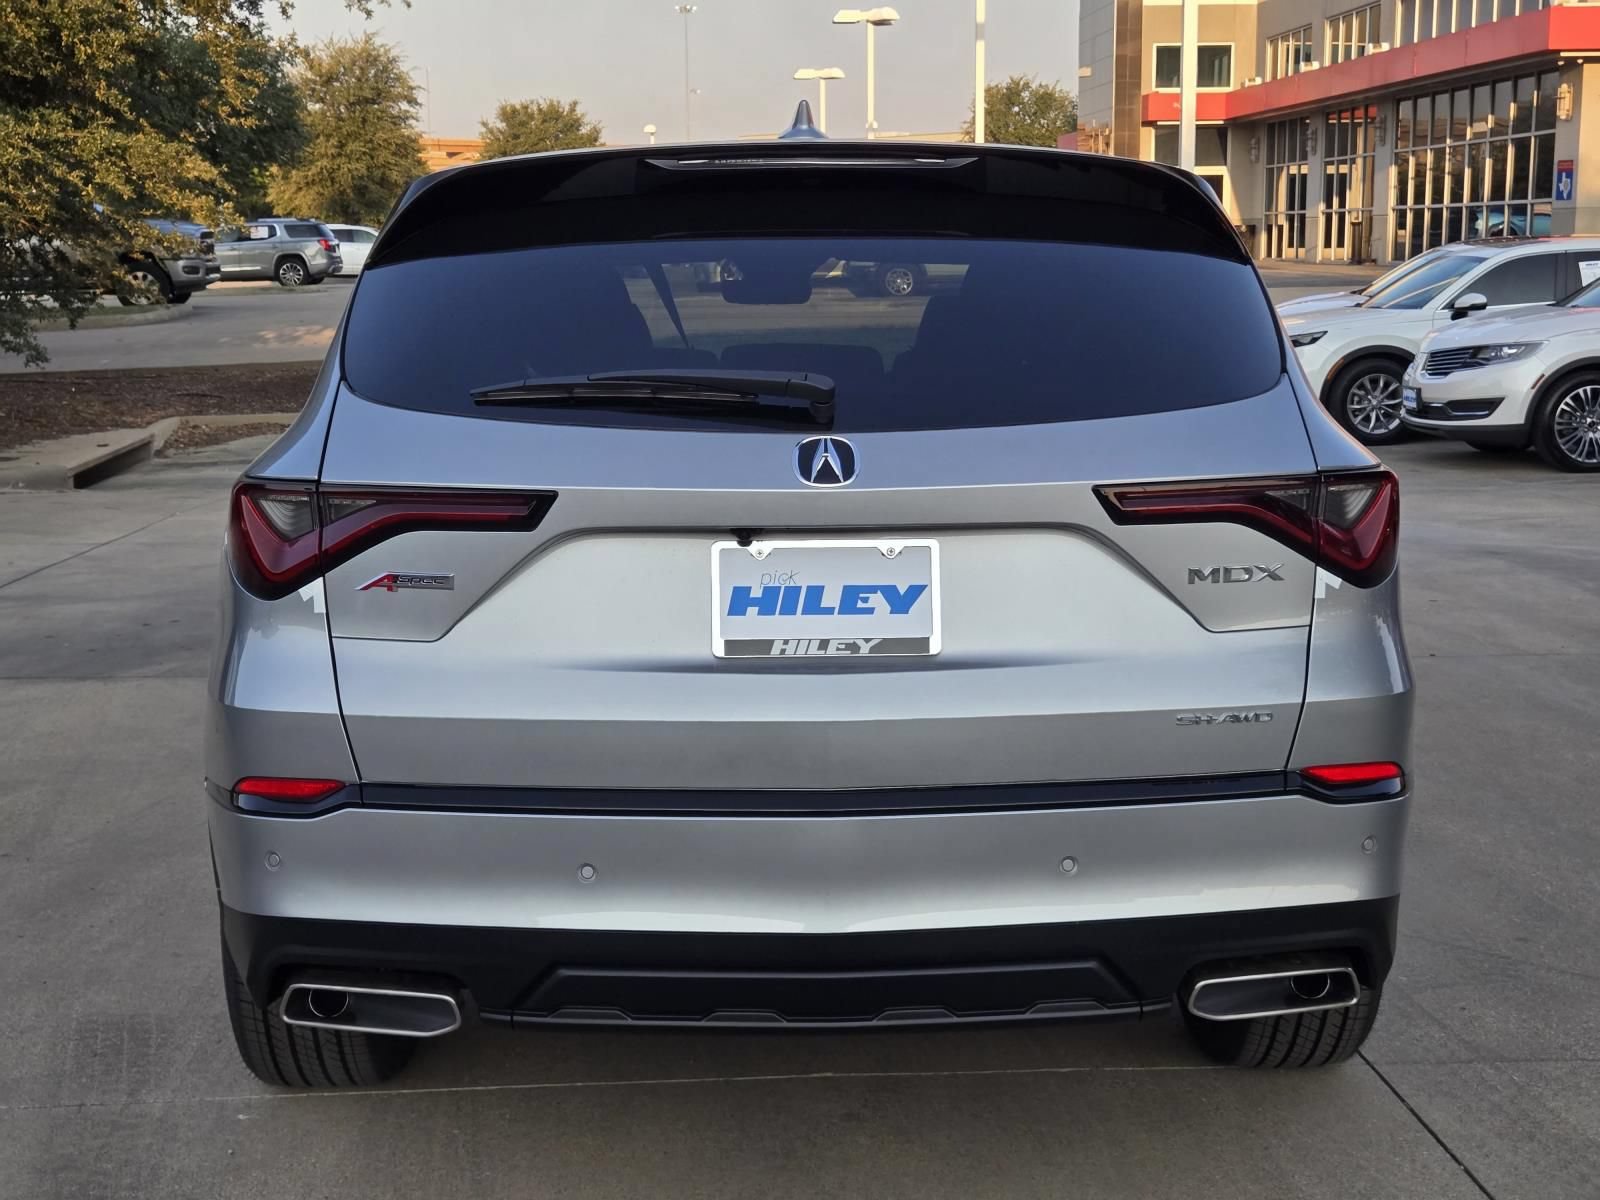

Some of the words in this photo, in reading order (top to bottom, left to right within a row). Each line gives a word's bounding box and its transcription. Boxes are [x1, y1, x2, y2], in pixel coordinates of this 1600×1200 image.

[760, 569, 801, 590] pick
[1187, 563, 1285, 585] MDX
[727, 584, 929, 617] HILEY
[770, 639, 884, 656] HILEY
